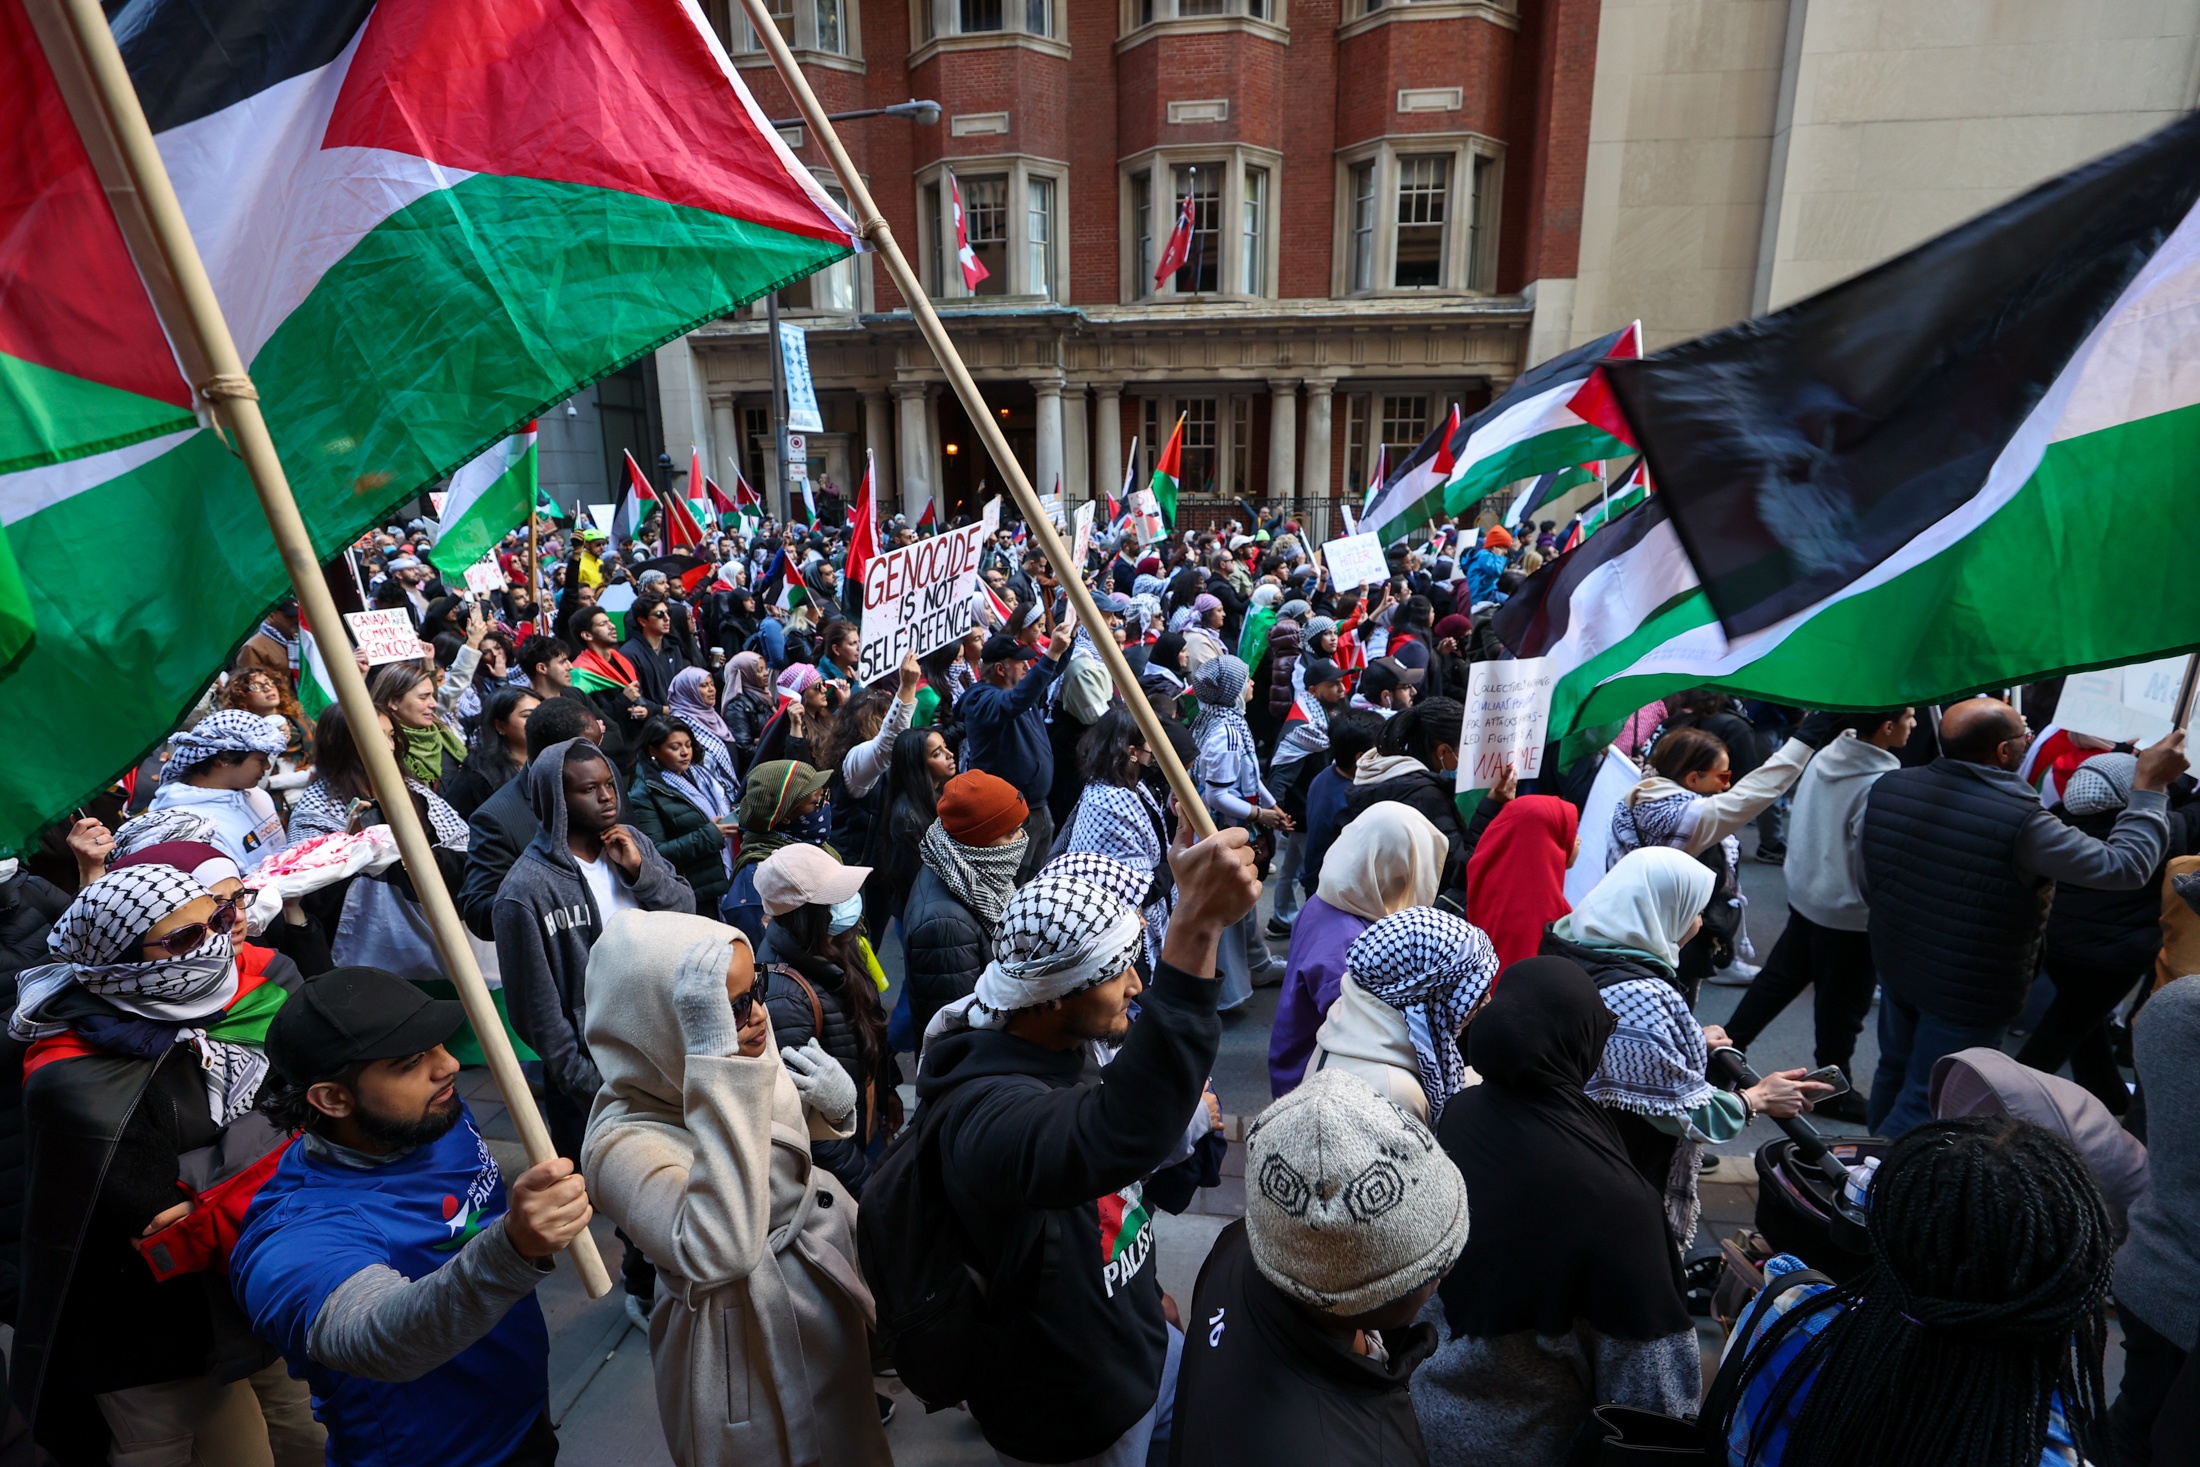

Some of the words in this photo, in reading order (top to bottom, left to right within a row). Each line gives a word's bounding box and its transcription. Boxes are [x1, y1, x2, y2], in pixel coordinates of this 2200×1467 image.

[1338, 549, 1374, 567] HITLER
[864, 525, 982, 611] GENOCIDE
[899, 591, 916, 625] IS
[923, 574, 960, 614] NOT
[352, 613, 390, 627] CANADA
[359, 627, 404, 642] COMPLICIT
[860, 596, 973, 682] SELF-DEFENCE
[365, 639, 420, 657] GENOCIDE
[1466, 719, 1480, 730] FOR
[1463, 734, 1480, 745] LED
[467, 1179, 478, 1197] RUN
